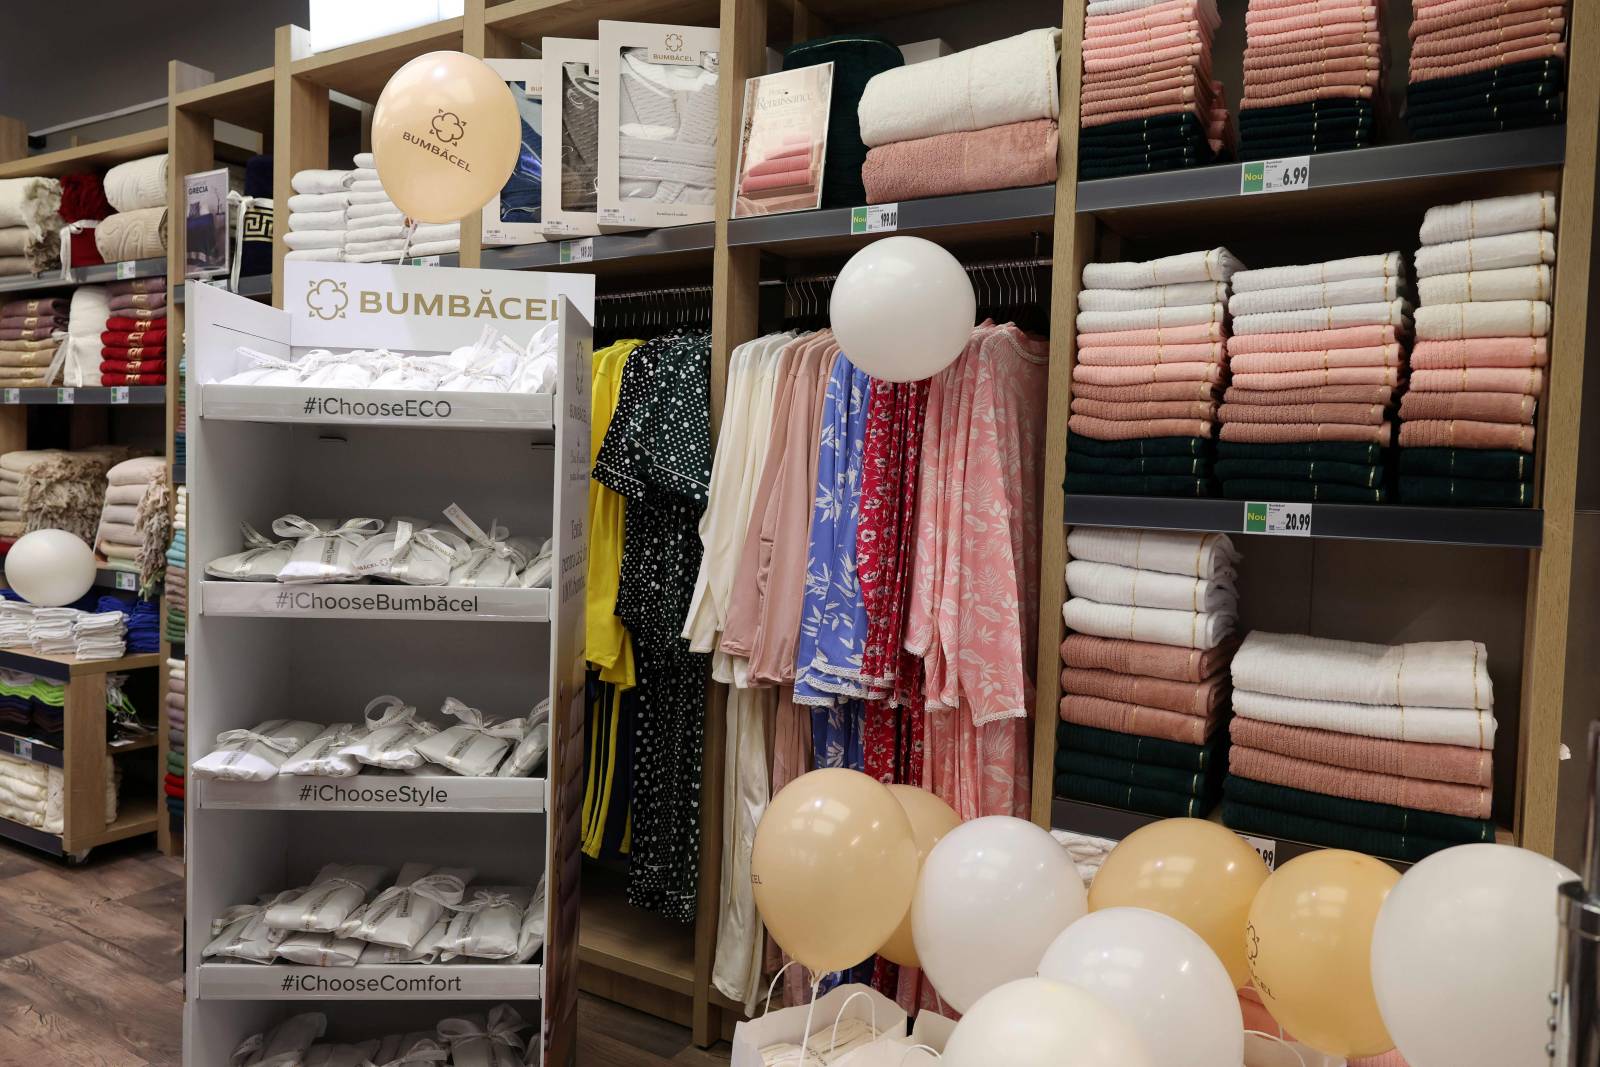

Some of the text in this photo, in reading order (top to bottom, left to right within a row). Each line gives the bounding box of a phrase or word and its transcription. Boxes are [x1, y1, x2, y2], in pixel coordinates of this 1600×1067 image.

[403, 131, 471, 173] BUMBĂCEL
[1245, 167, 1308, 186] Nou 6.99
[188, 185, 208, 195] GRECIA
[304, 396, 452, 418] #iChooseECO
[1247, 512, 1310, 531] Nou 20.99
[275, 591, 478, 612] #iChooseBumbăcel
[298, 784, 448, 806] #iChooseStyle
[281, 974, 462, 992] #iChooseComfort
